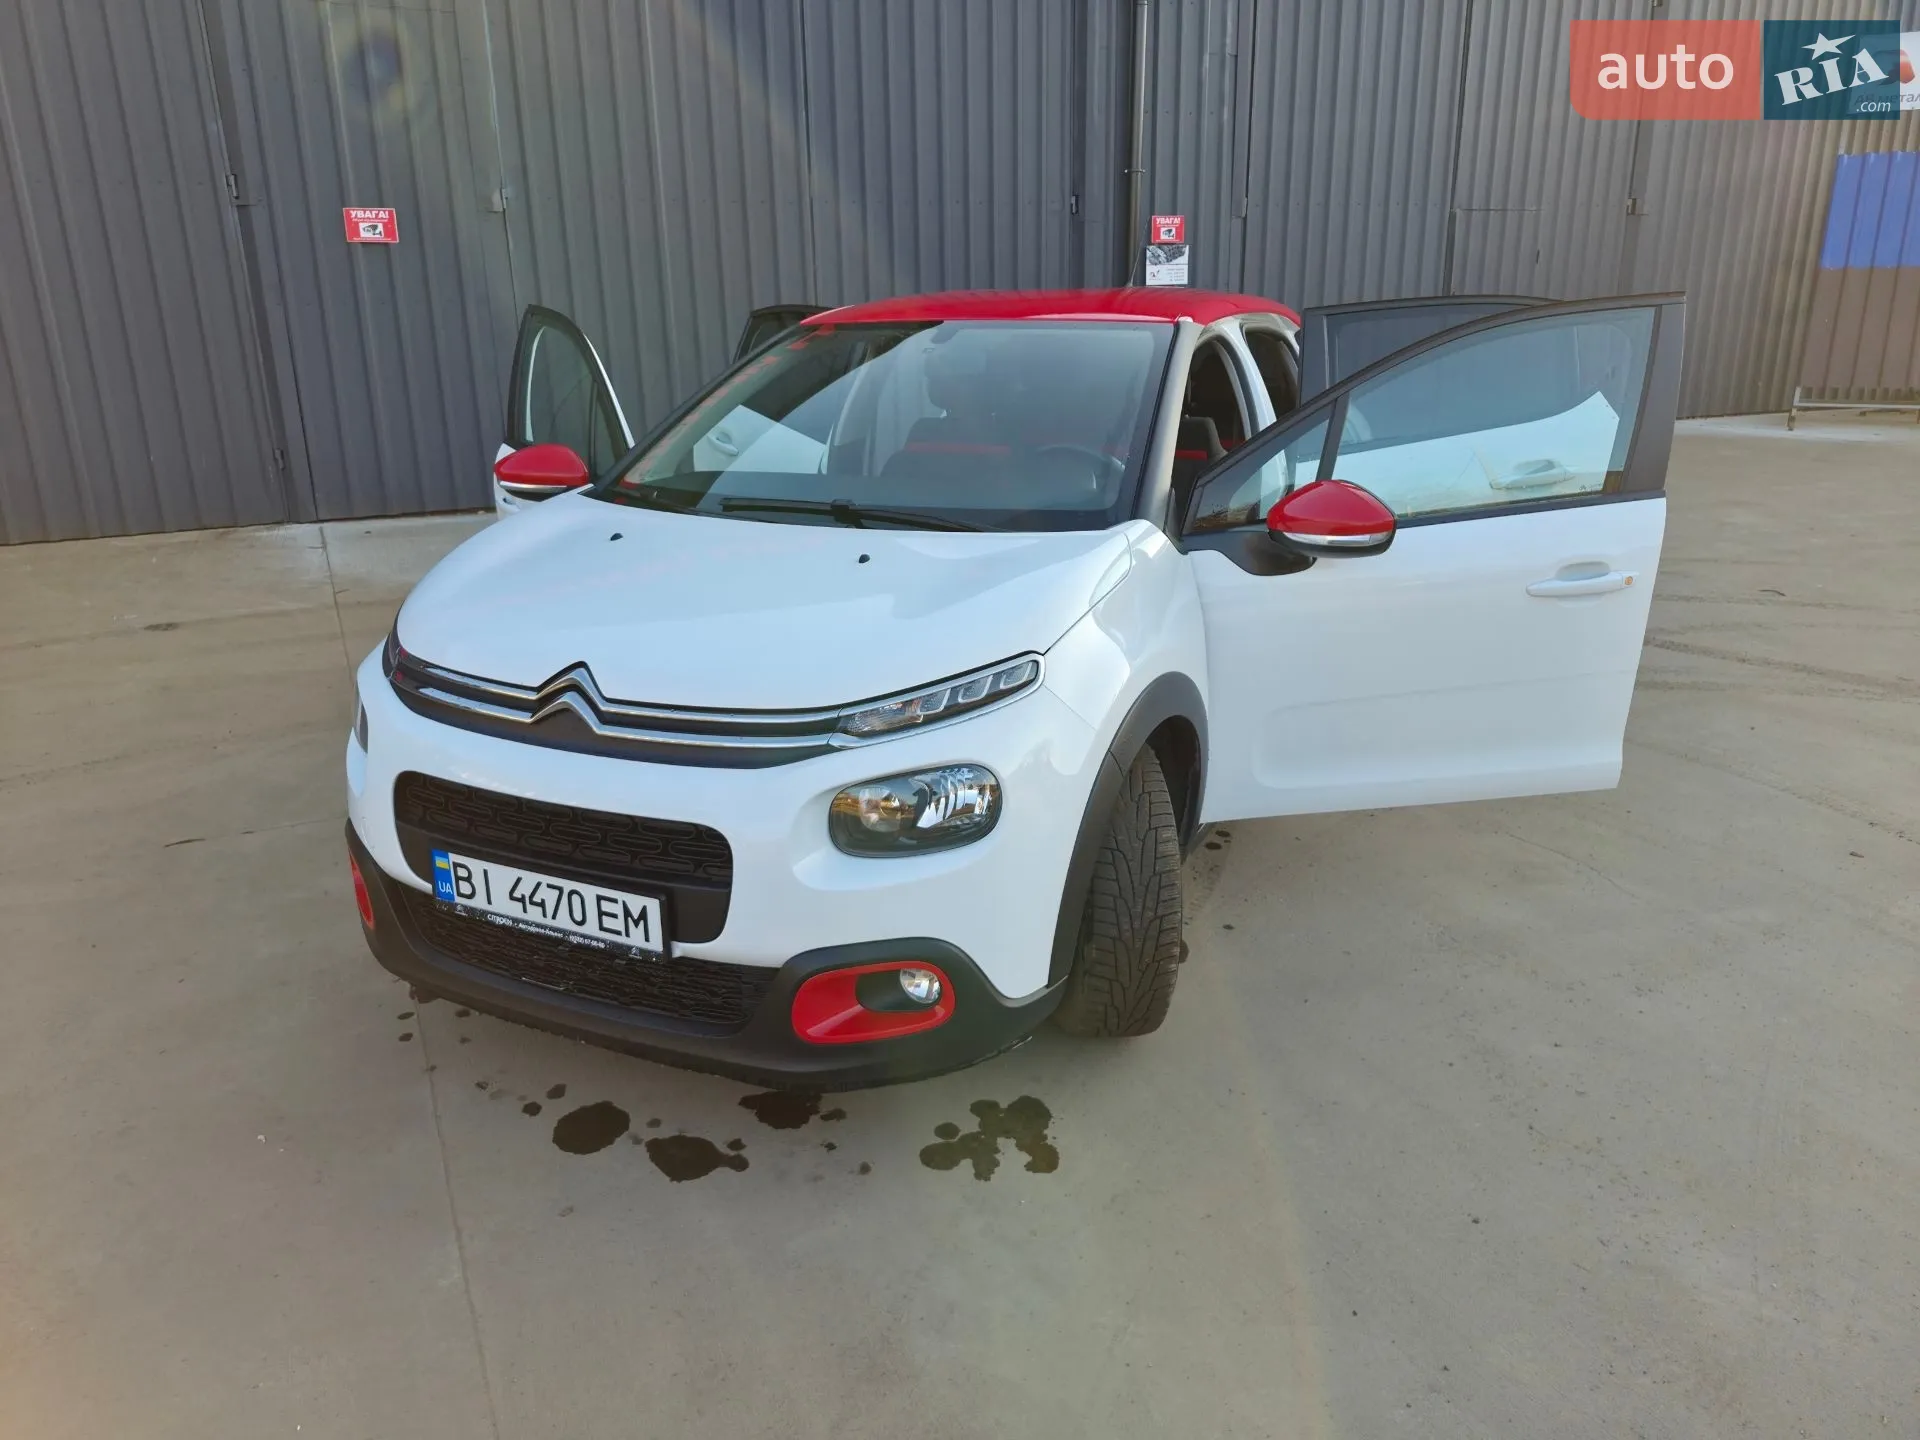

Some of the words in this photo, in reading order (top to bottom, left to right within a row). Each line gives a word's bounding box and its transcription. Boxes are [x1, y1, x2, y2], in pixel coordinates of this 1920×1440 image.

[350, 210, 389, 218] УВАГА!
[438, 880, 453, 895] UA
[452, 861, 492, 906] BI
[508, 875, 588, 927] 4470
[596, 893, 650, 943] EM
